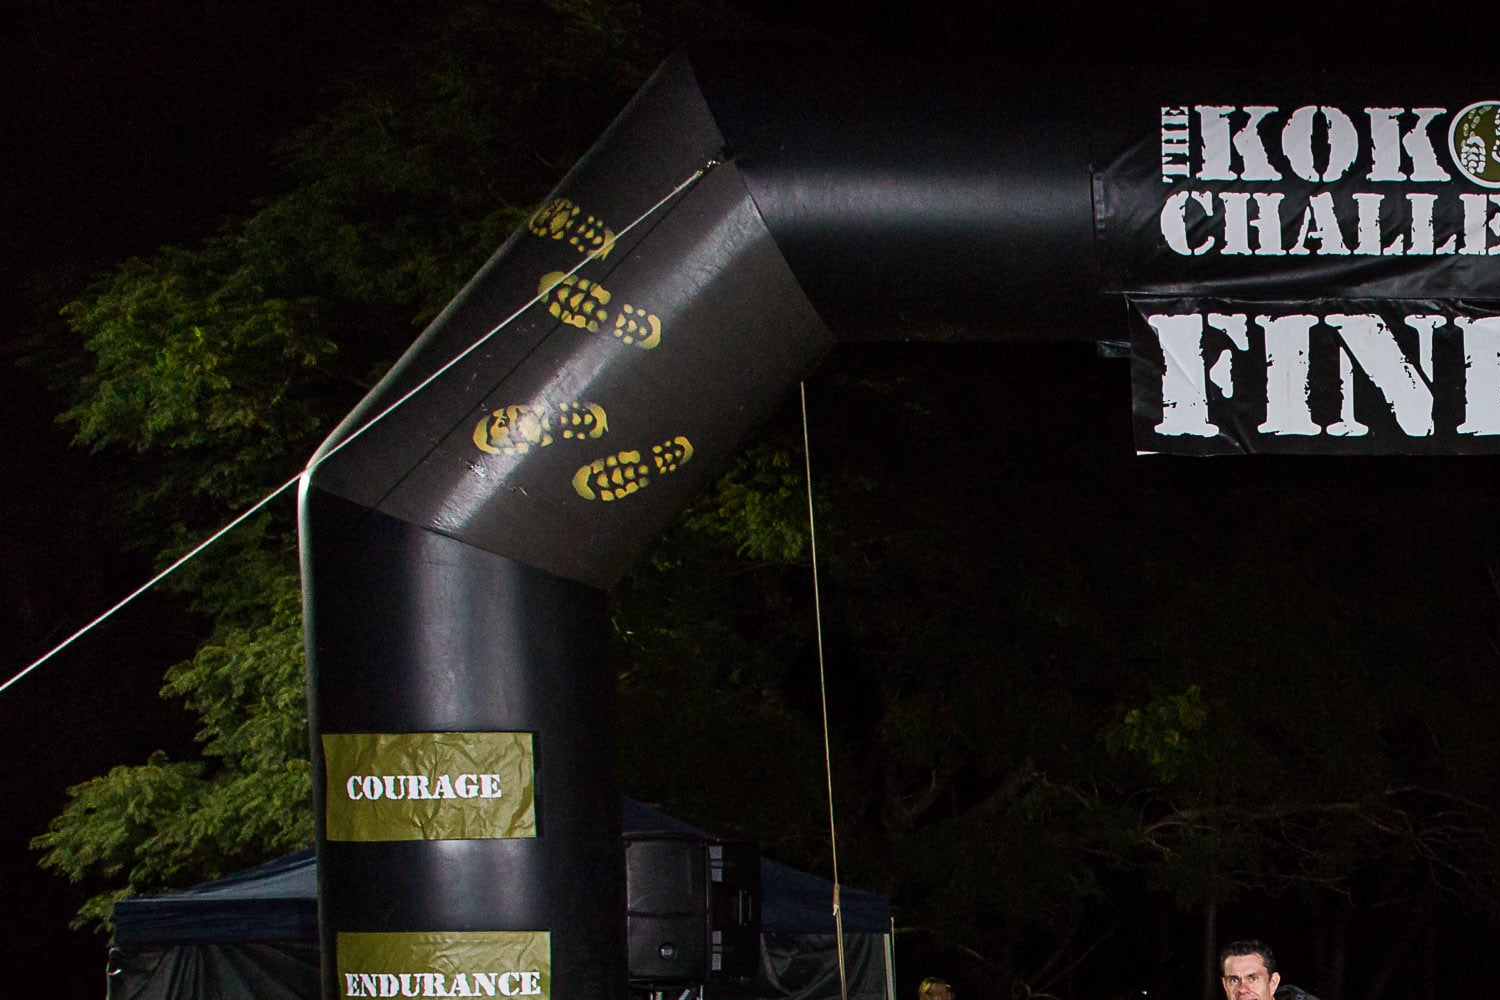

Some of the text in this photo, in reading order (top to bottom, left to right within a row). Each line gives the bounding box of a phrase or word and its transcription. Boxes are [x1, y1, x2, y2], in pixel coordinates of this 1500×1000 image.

[1160, 106, 1189, 183] THE
[346, 773, 502, 801] COURAGE
[344, 972, 541, 998] ENDURANCE
